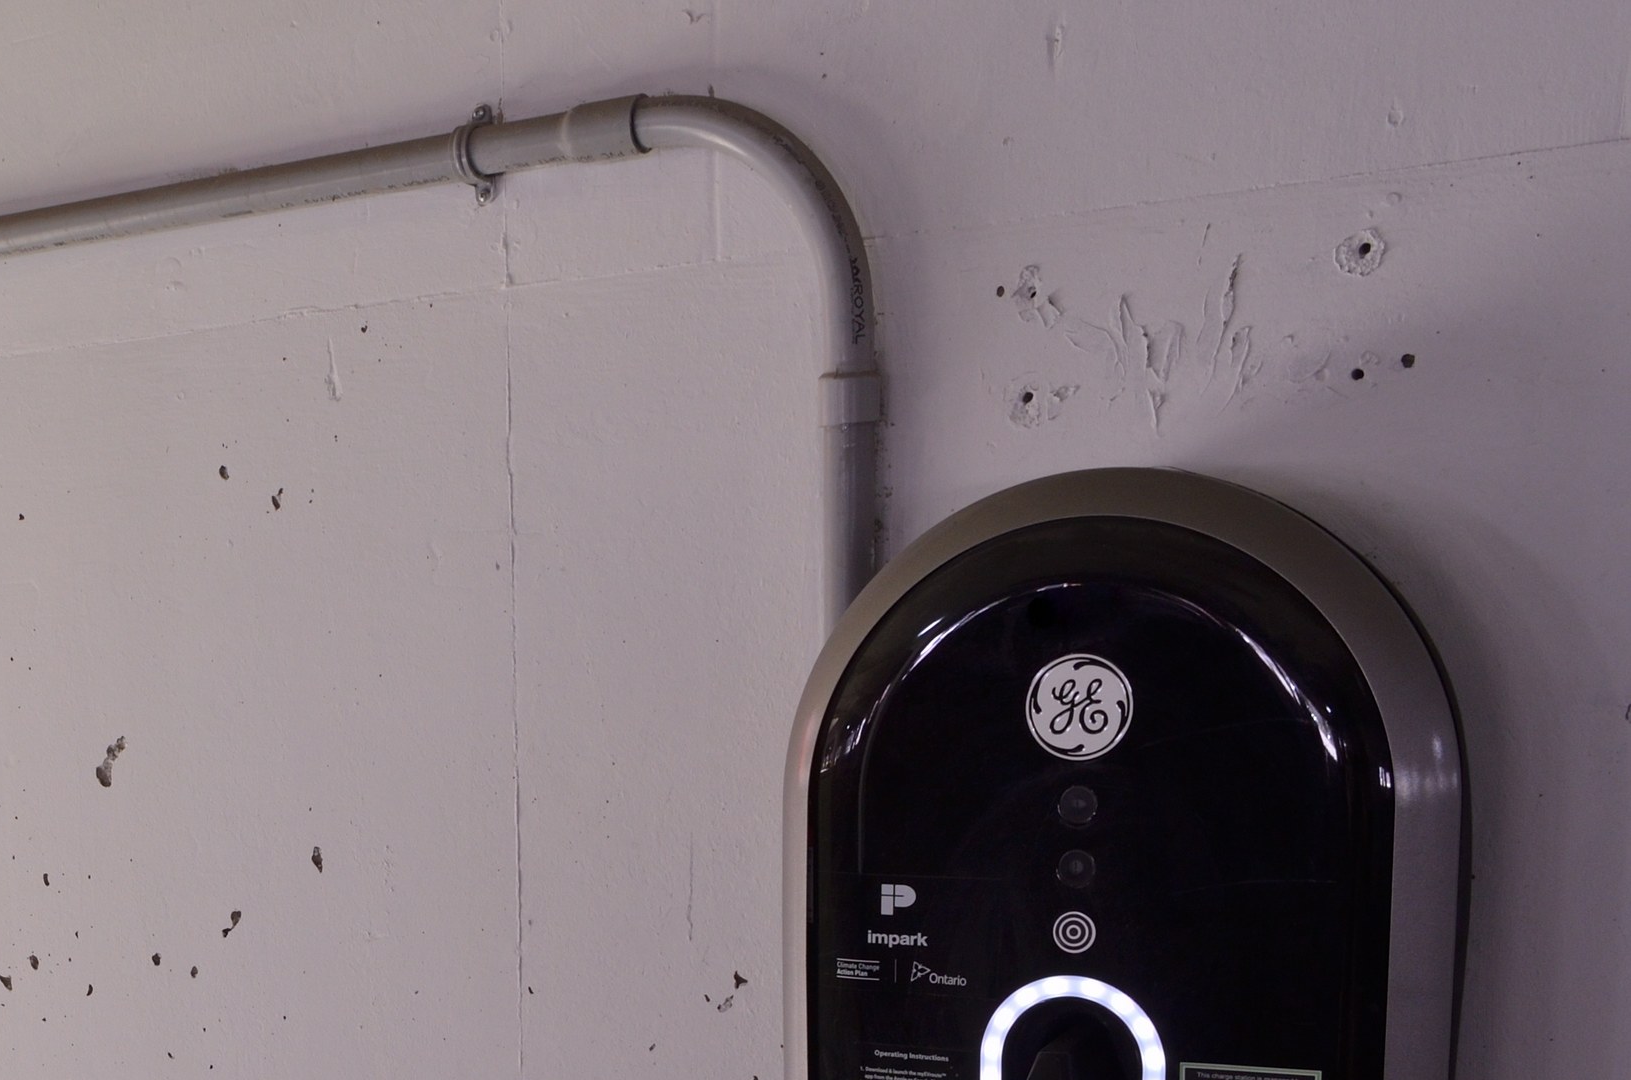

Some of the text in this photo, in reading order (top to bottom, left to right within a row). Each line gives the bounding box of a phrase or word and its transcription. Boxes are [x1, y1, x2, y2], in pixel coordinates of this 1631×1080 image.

[852, 284, 866, 345] ROYAL
[867, 929, 928, 948] impark
[836, 961, 880, 971] Climate Change
[929, 973, 967, 986] Ontario
[874, 1049, 949, 1062] Operating Instructions
[1197, 1071, 1210, 1079] This
